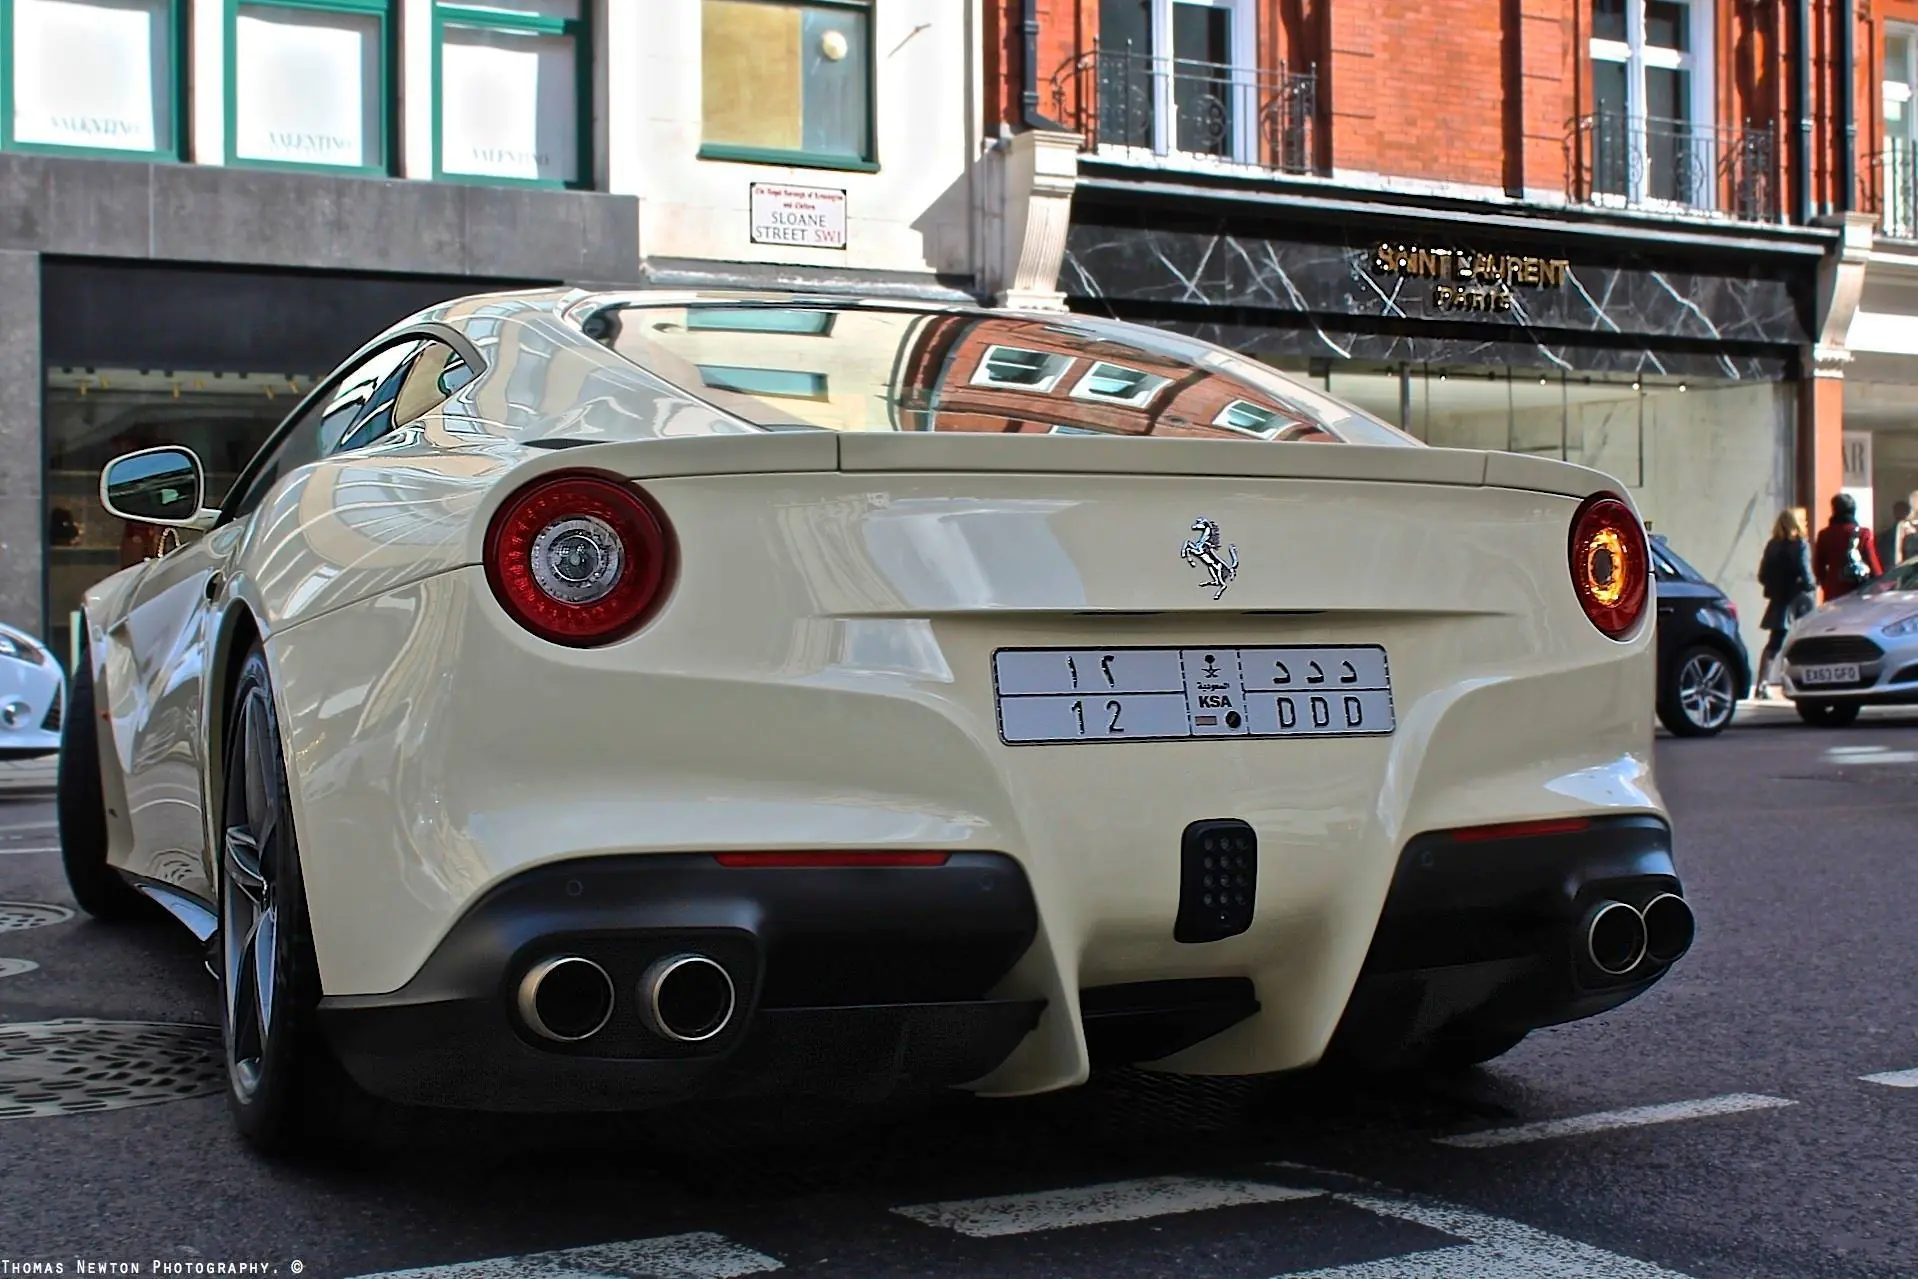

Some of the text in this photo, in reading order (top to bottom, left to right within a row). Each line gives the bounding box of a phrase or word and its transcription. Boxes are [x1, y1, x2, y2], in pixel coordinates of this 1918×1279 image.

[269, 132, 352, 153] VALENTINO
[771, 211, 826, 228] SLOANE
[756, 226, 841, 243] STREET SW1
[1377, 242, 1570, 288] SAINT LAURENT
[1434, 284, 1513, 315] PARIS
[1199, 695, 1232, 708] KSA
